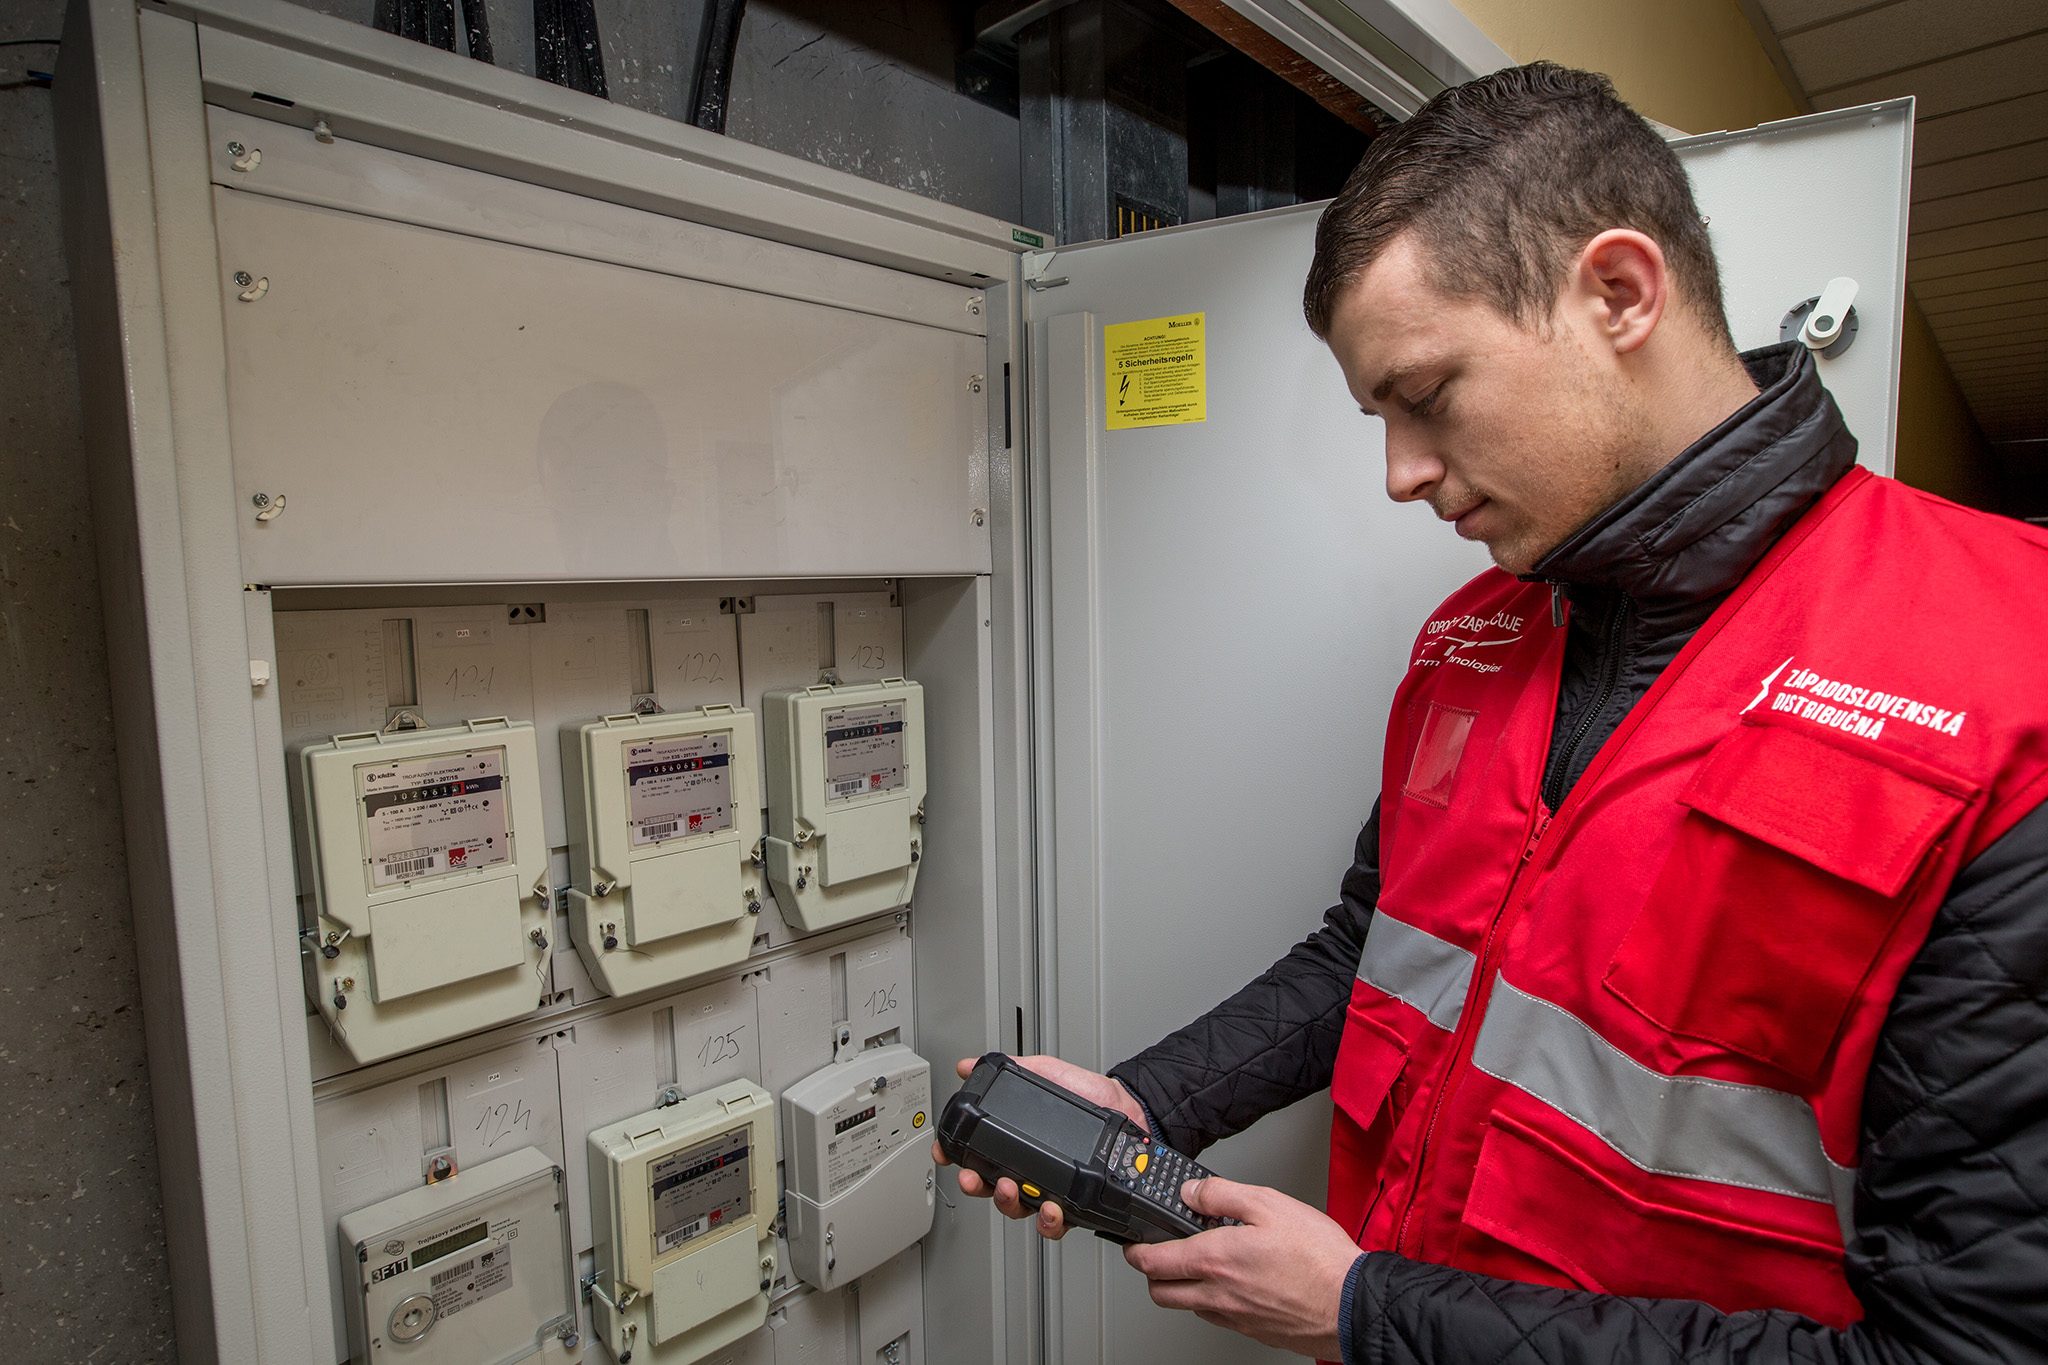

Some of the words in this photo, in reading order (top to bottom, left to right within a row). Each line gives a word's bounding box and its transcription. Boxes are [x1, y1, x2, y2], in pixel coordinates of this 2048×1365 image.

[1118, 360, 1123, 369] 5
[1125, 353, 1194, 368] Sicherheitsregeln
[678, 652, 724, 684] 122
[850, 645, 885, 670] 123
[445, 664, 494, 701] 121
[1770, 692, 1887, 741] DISTRIBUČNÁ
[1783, 668, 1967, 737] ZÁPADOSLOVENSKÁ
[864, 983, 897, 1018] 126
[697, 1025, 746, 1068] 125
[476, 1099, 531, 1148] 124
[373, 1258, 408, 1283] 3F1T
